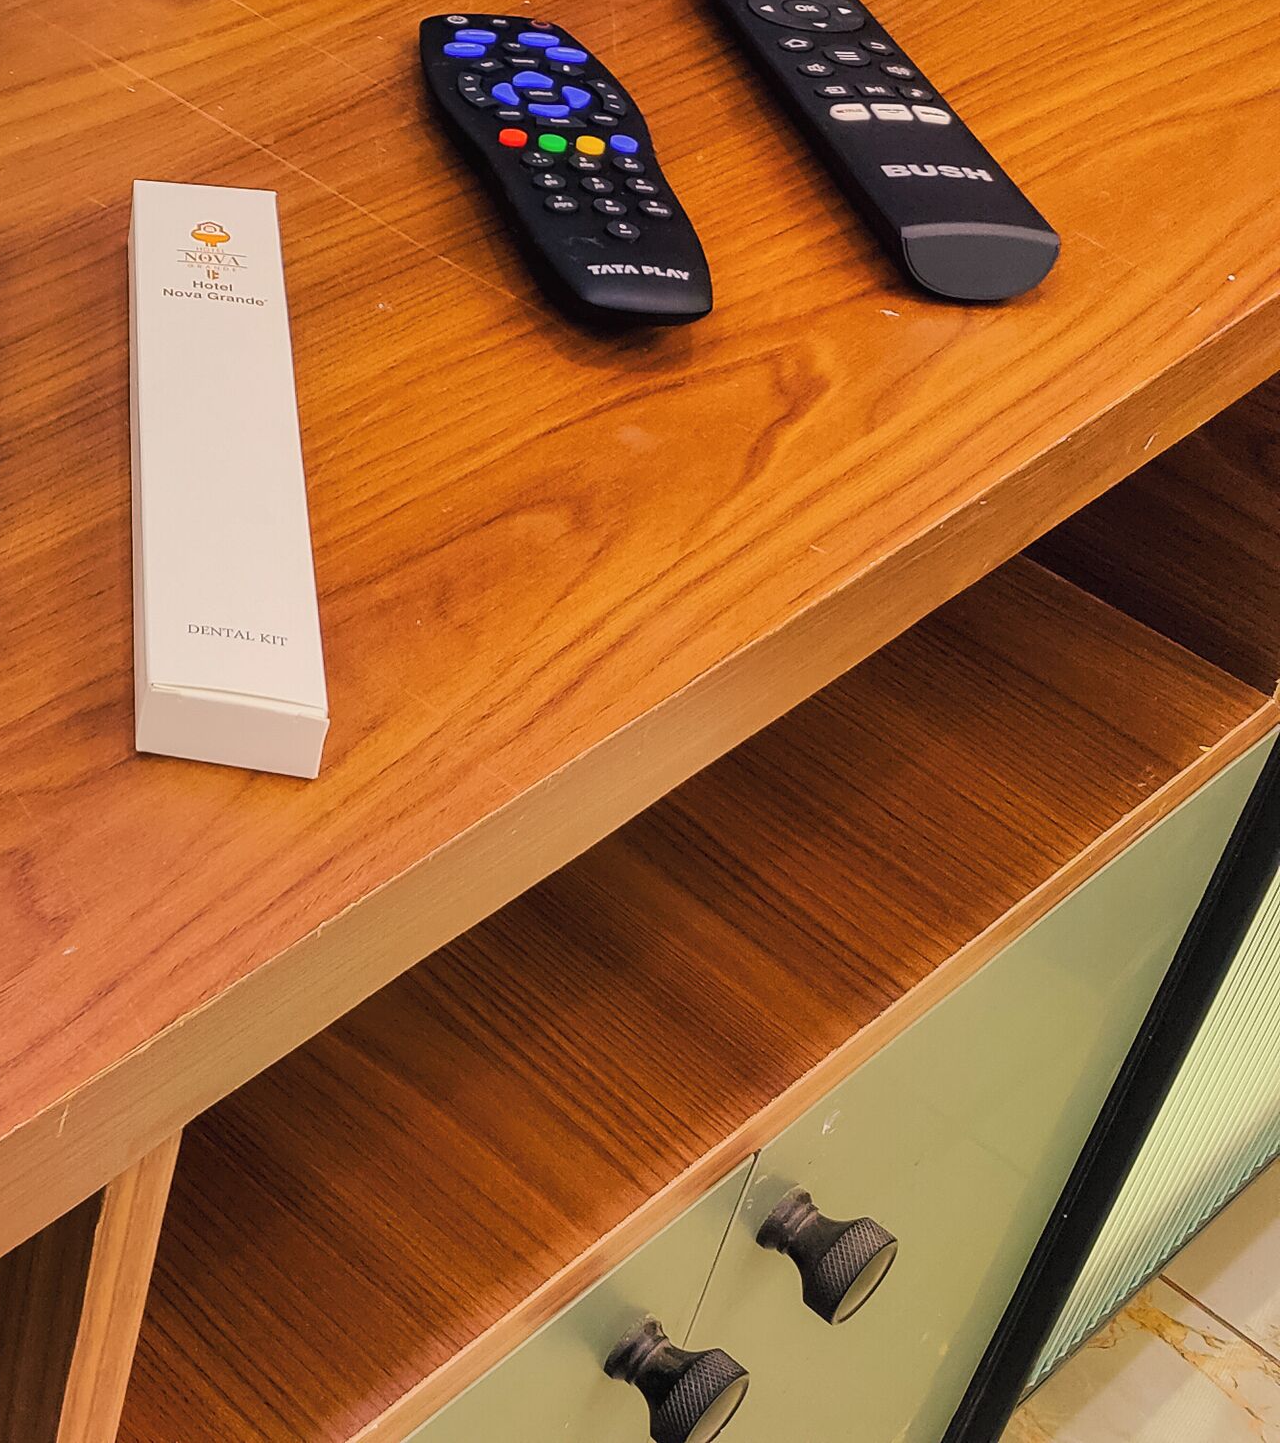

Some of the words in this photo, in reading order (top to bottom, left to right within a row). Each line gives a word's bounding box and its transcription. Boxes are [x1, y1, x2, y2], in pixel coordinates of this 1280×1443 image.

[794, 3, 819, 13] OK
[880, 163, 995, 183] BUSH
[184, 252, 240, 266] NOVA
[586, 263, 639, 277] TATA
[641, 264, 690, 281] PLAY
[192, 280, 233, 292] Hotel
[162, 288, 203, 300] Nova
[207, 292, 265, 307] Grande
[187, 623, 256, 642] DENTAL
[259, 633, 289, 647] KIT
